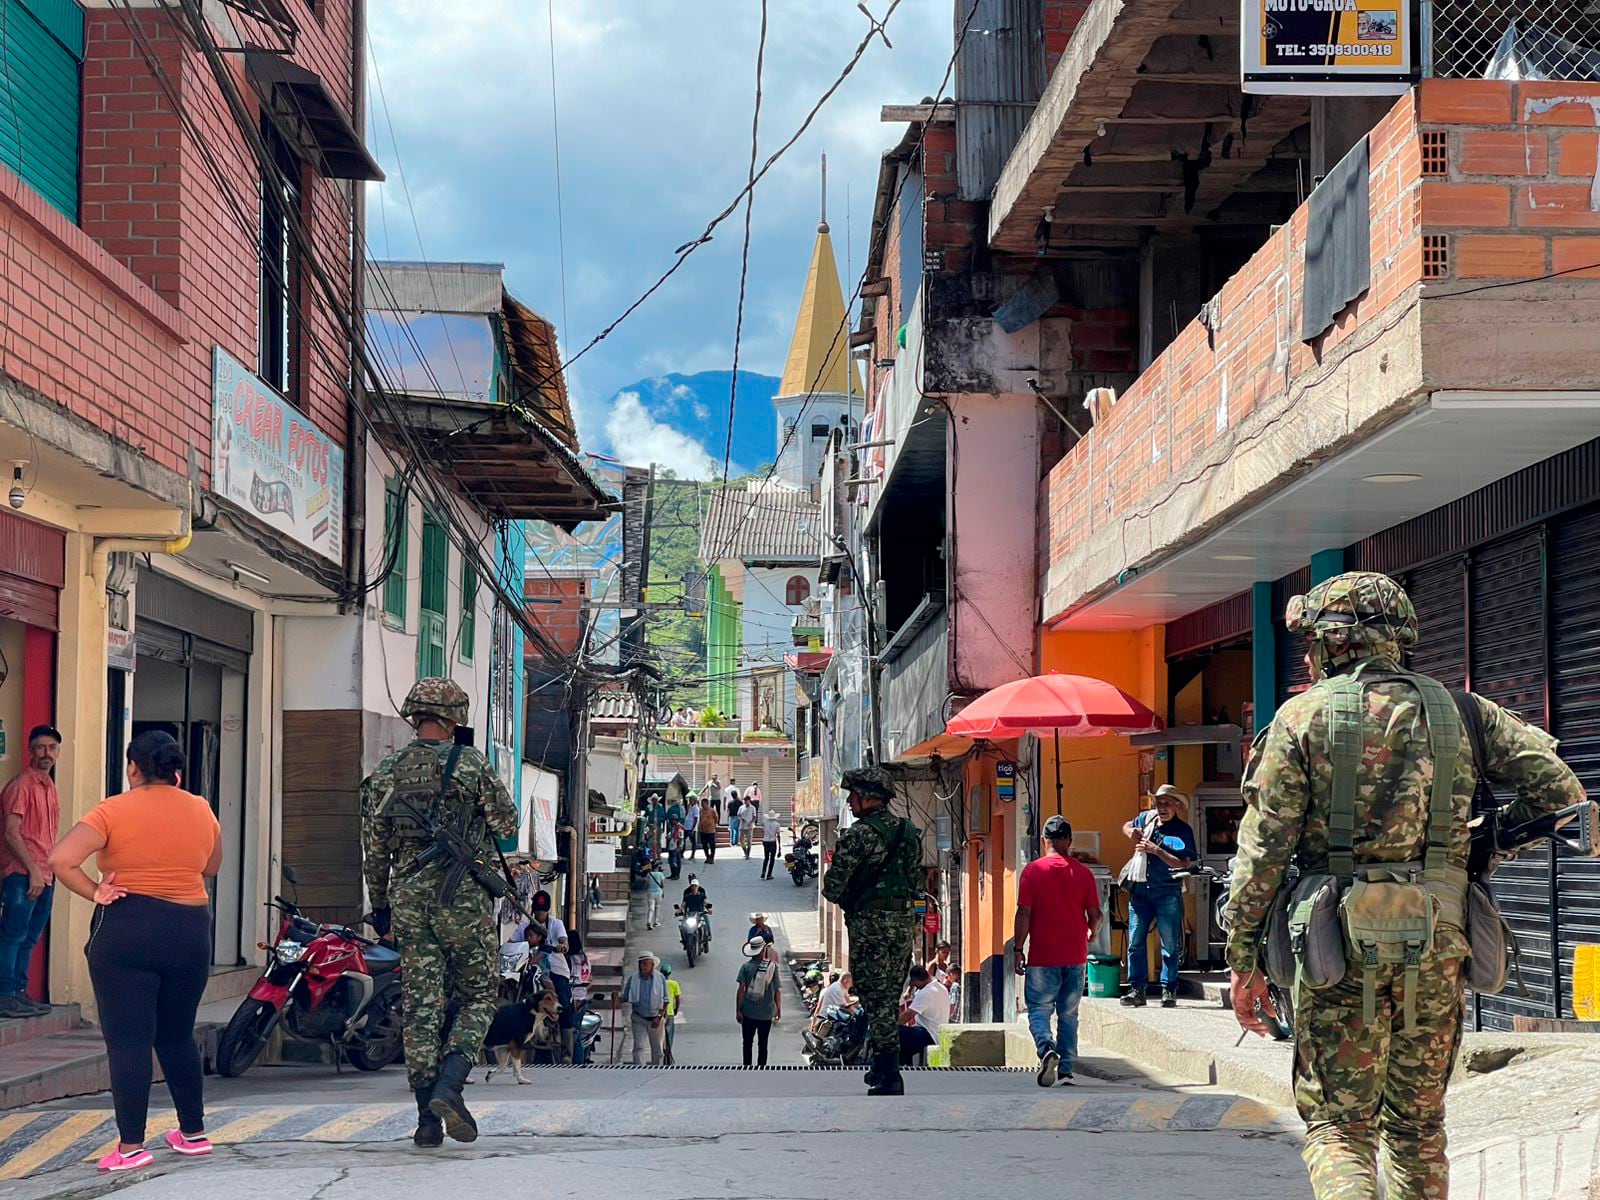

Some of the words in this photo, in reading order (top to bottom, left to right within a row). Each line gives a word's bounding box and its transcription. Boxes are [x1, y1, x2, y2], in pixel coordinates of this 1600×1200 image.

[1275, 44, 1306, 56] TEL:
[1308, 44, 1392, 56] 3508300418
[218, 391, 233, 414] PISO
[232, 378, 284, 455] CREAR
[288, 419, 329, 487] FOTOS
[998, 764, 1013, 775] tigo
